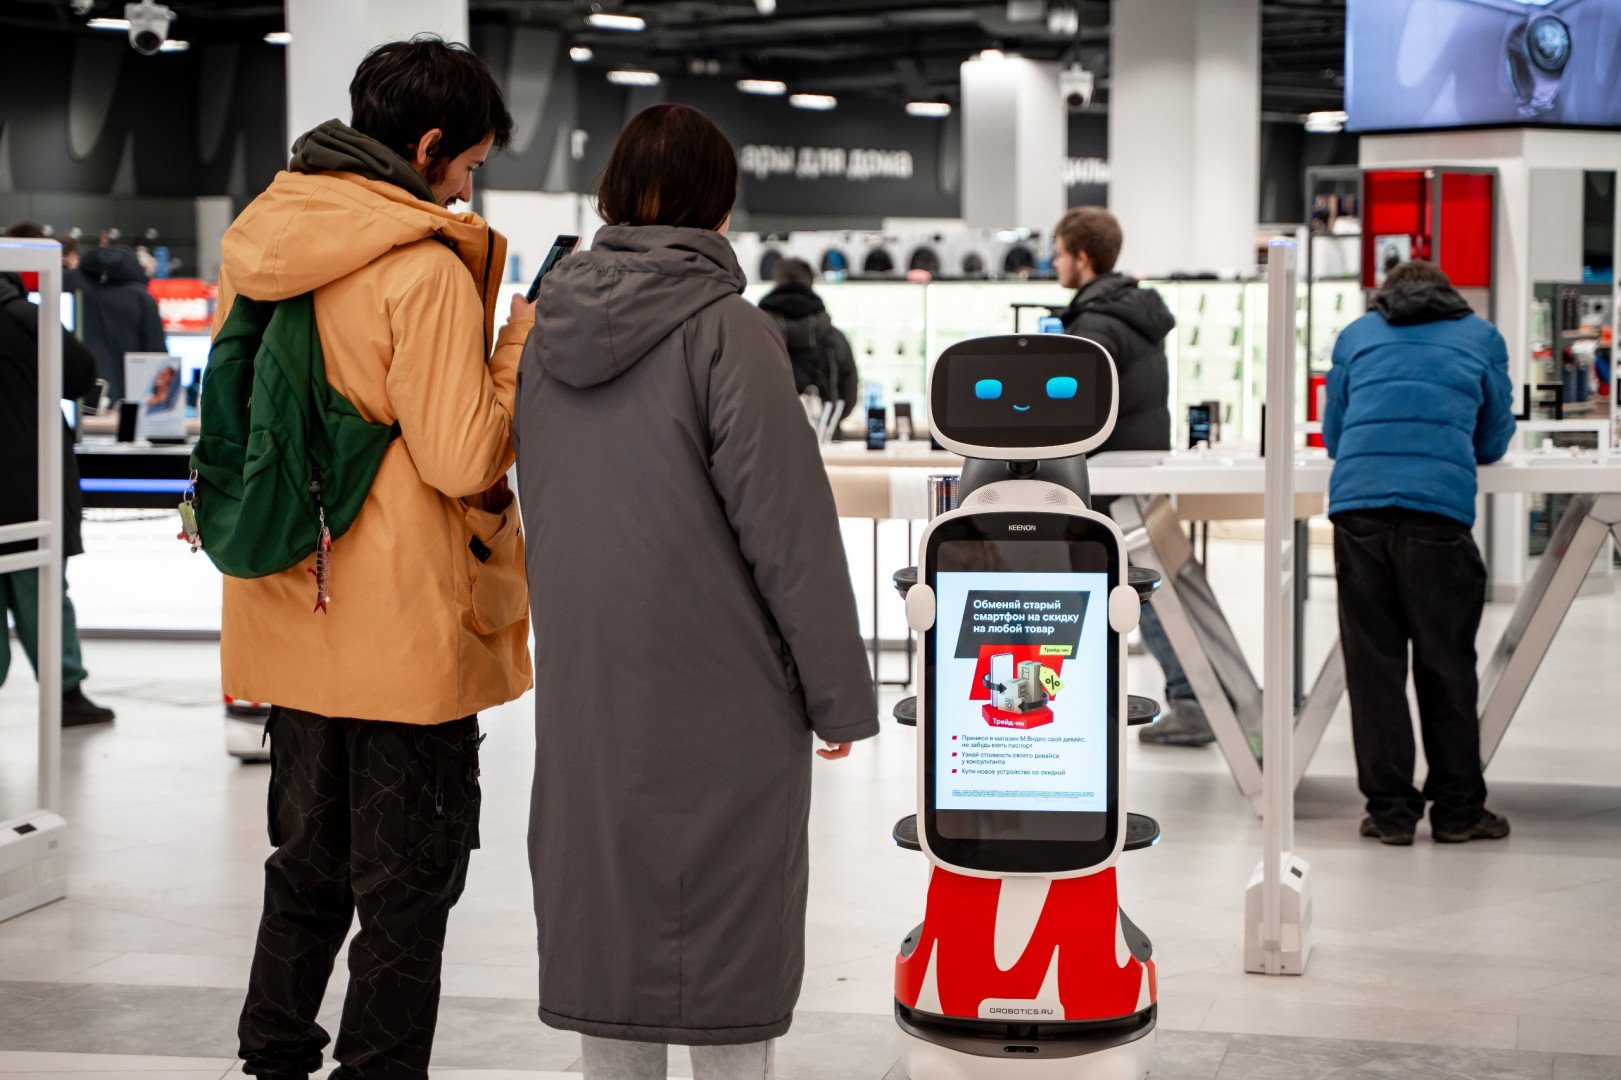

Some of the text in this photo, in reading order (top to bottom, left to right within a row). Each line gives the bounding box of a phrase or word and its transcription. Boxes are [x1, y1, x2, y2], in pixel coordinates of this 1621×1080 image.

[741, 144, 796, 180] ары
[847, 149, 913, 181] дома
[973, 599, 1061, 611] Обменяй старый
[973, 612, 1079, 623] смартфон на скидку
[973, 623, 1055, 635] на любой товар
[992, 717, 1025, 727] Трейд-ин
